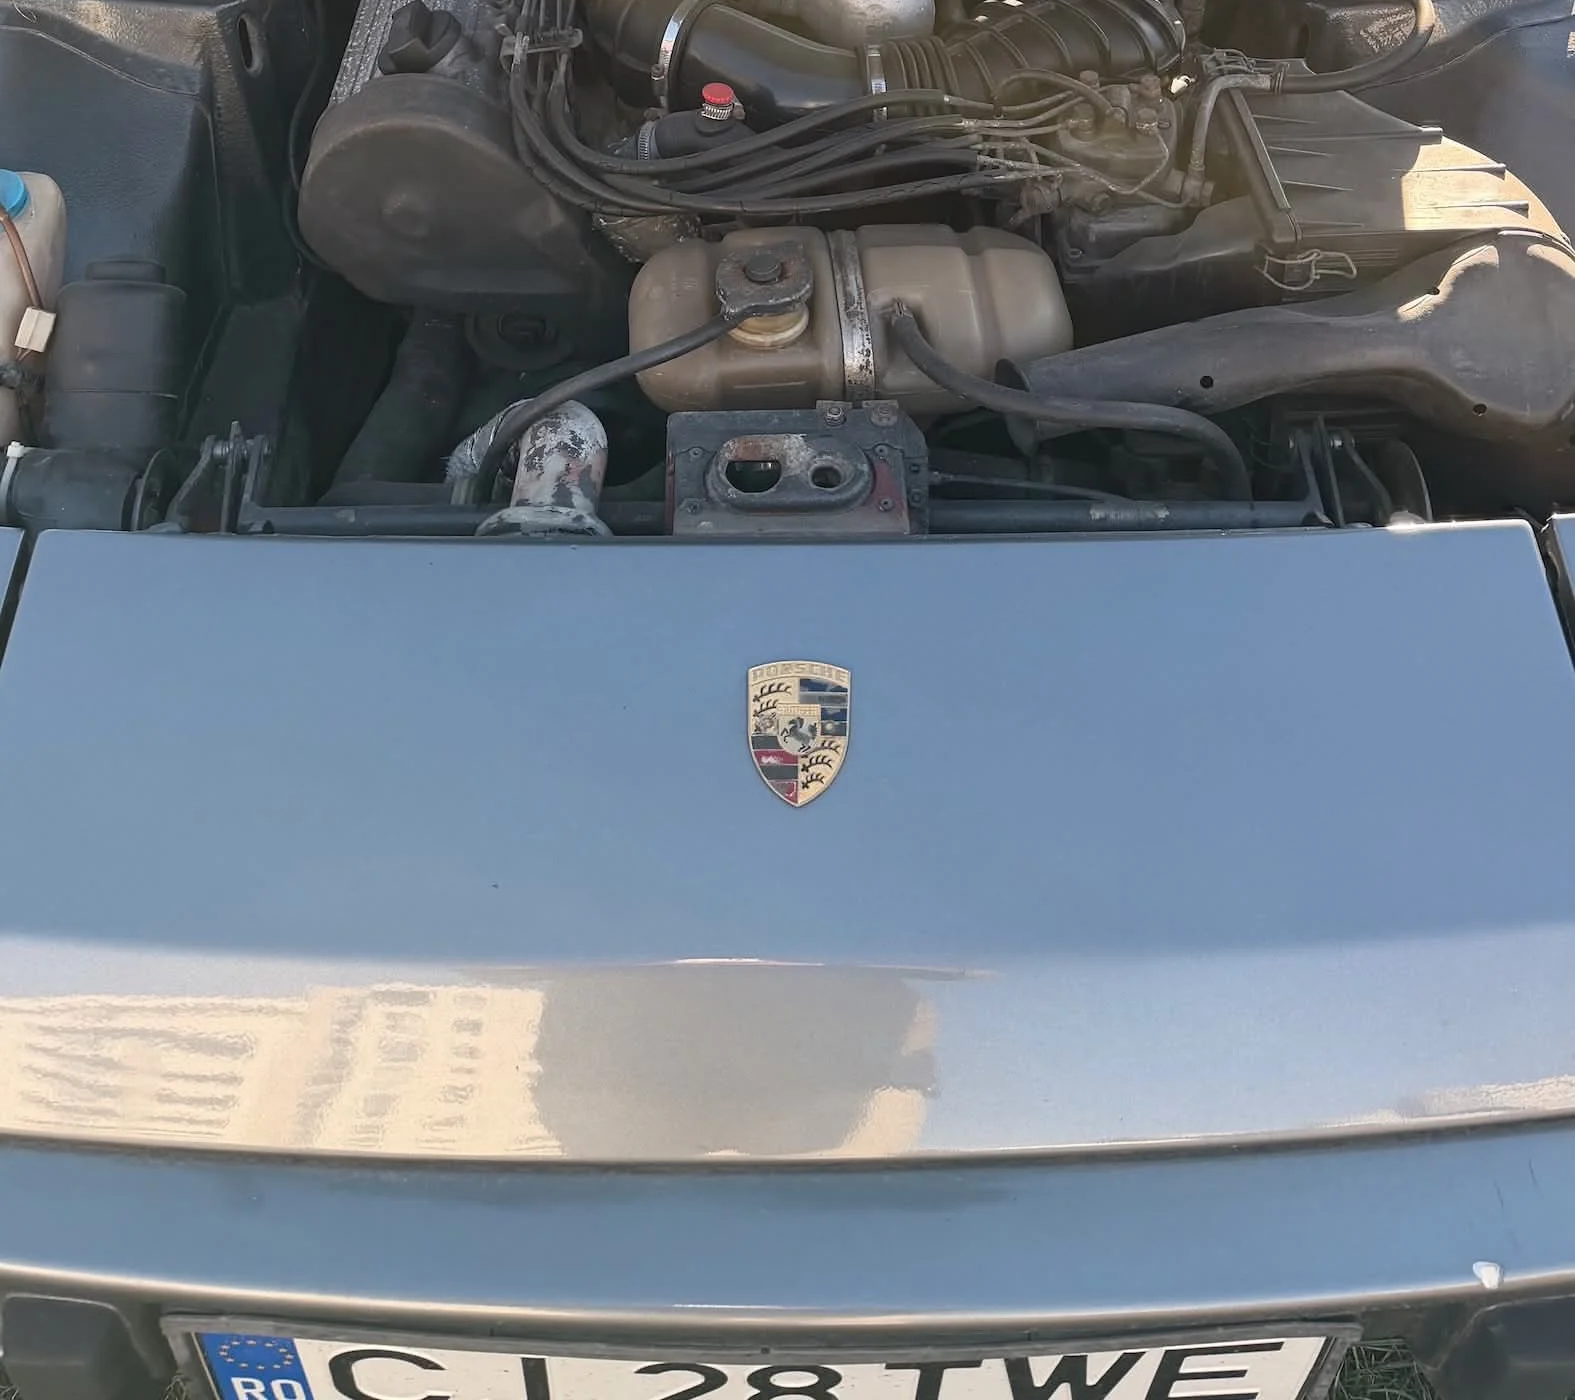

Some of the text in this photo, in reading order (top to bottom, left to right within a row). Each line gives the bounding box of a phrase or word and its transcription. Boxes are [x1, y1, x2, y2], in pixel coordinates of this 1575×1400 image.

[752, 662, 848, 682] PORSCHE
[634, 1362, 842, 1400] 28
[884, 1341, 1284, 1400] TWE
[231, 1376, 303, 1400] RO
